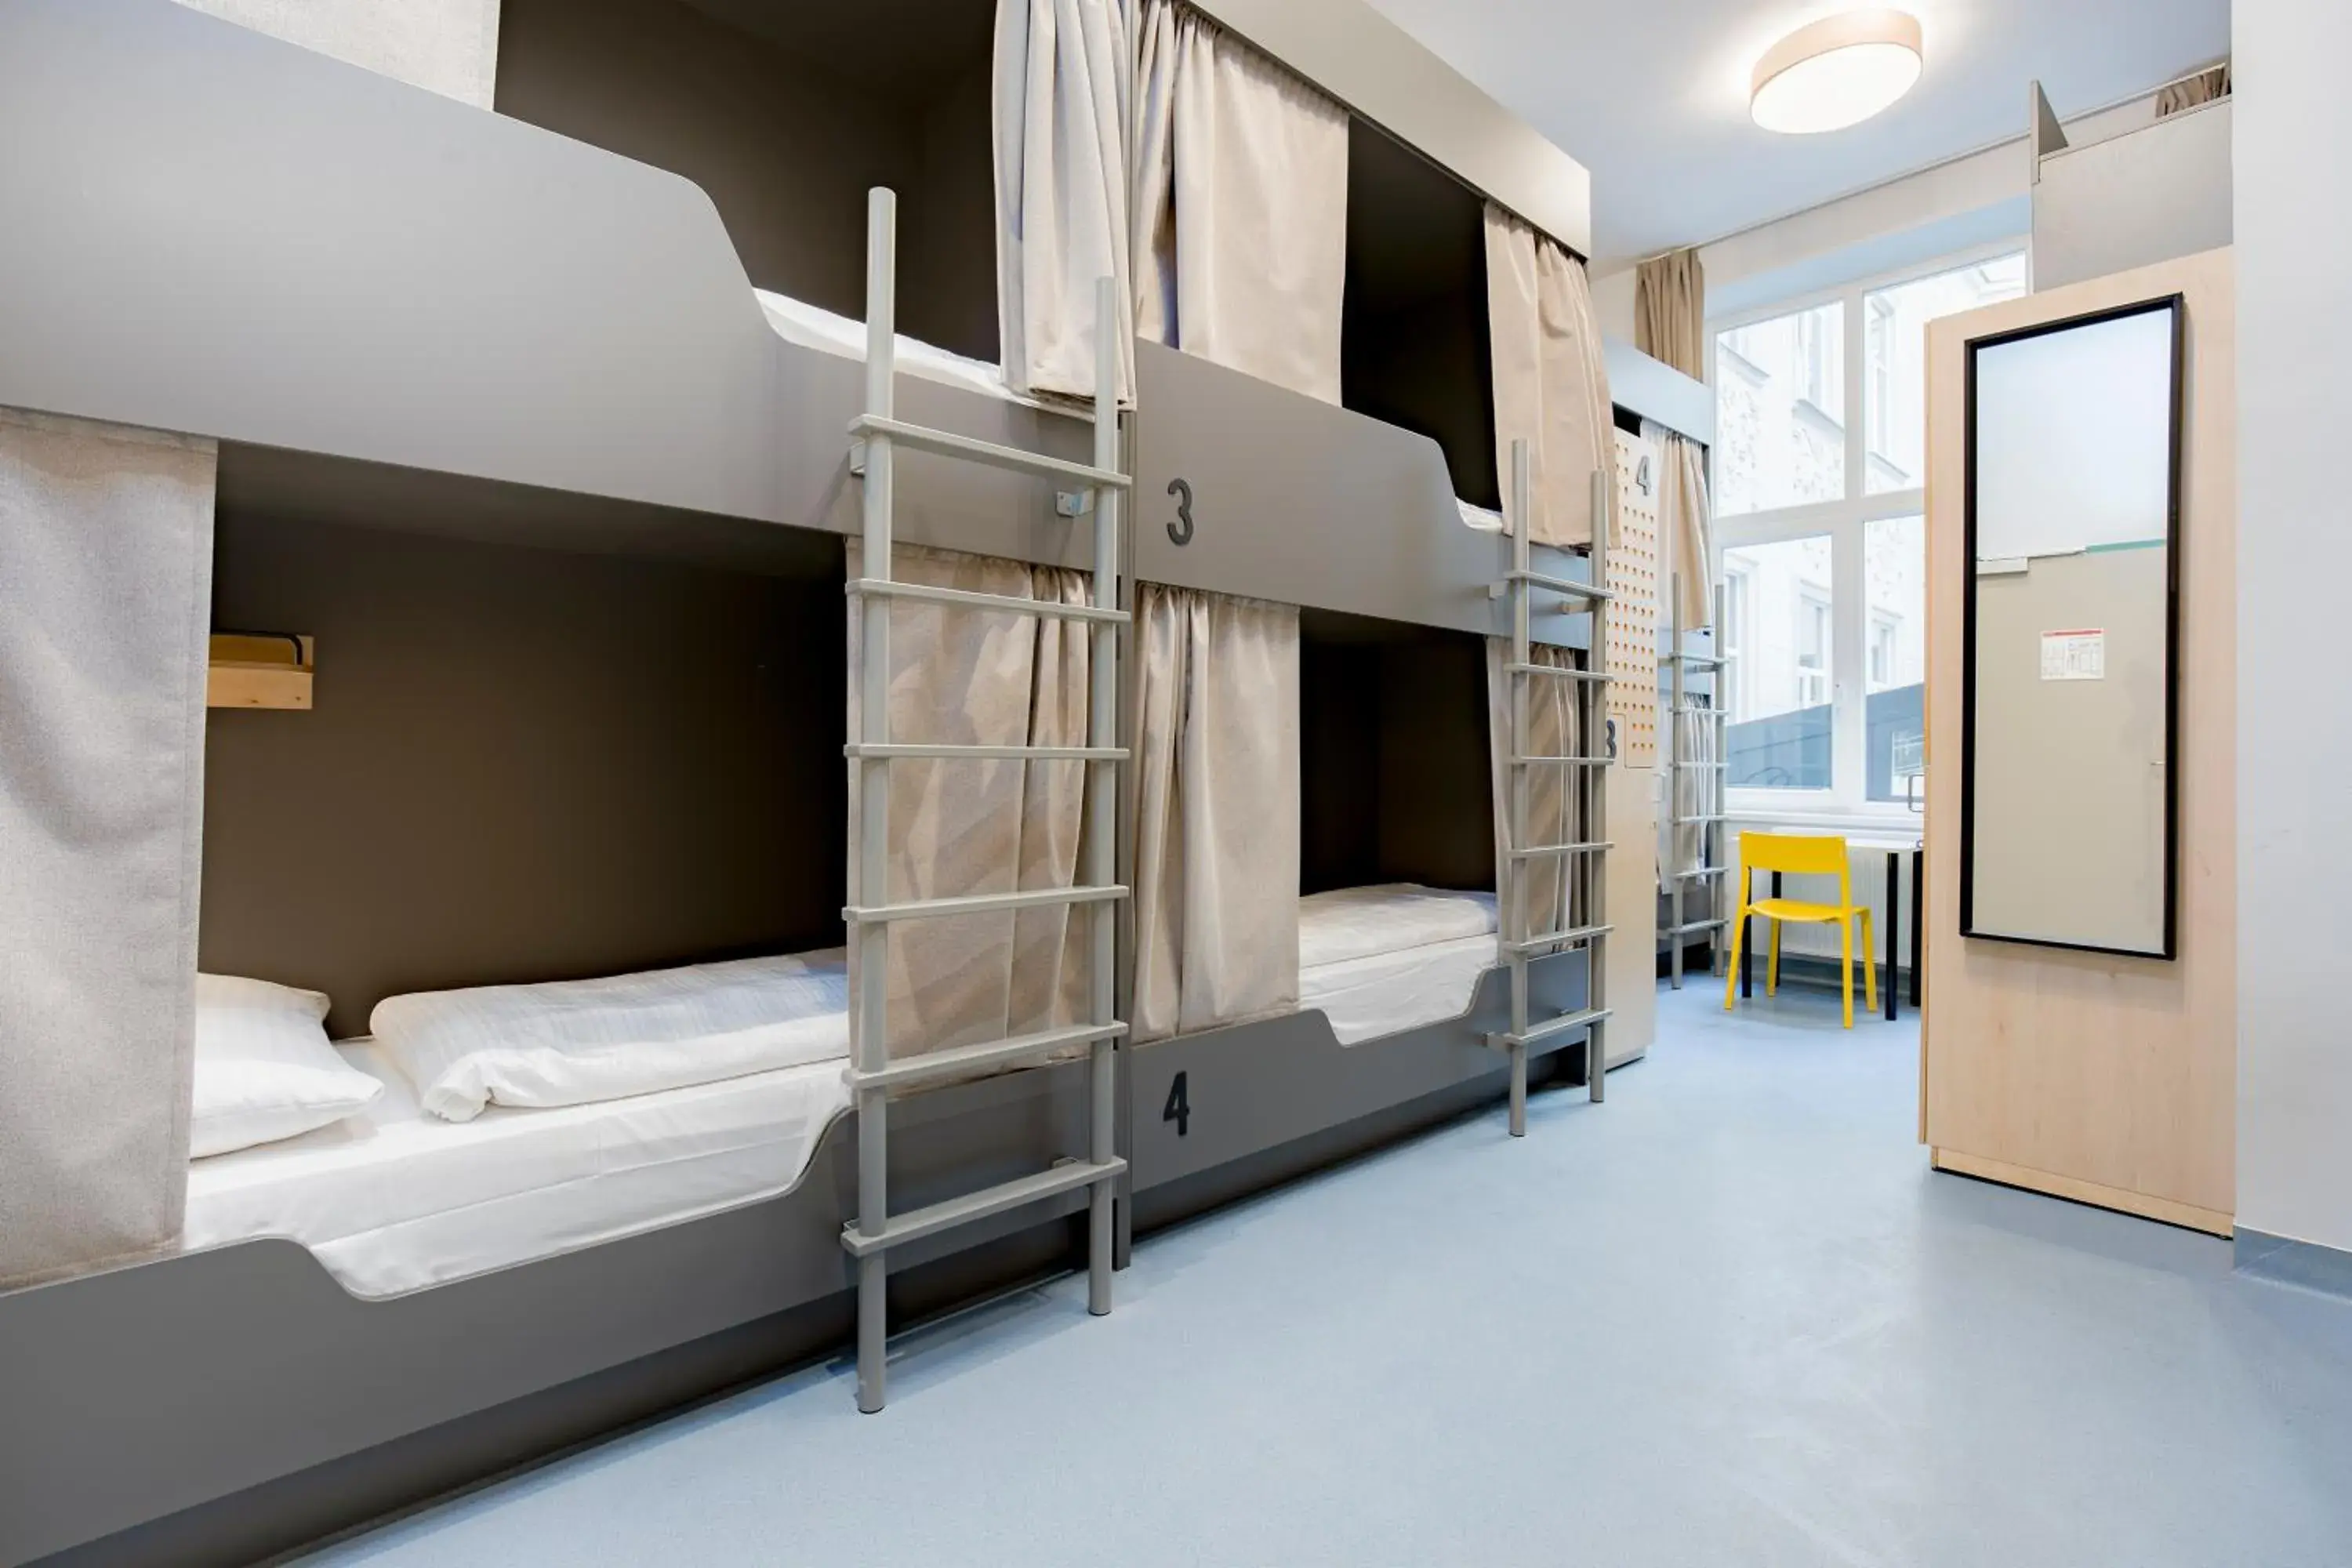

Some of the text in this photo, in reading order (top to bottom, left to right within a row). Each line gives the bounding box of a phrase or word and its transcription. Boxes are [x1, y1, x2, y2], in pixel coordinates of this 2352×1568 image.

[1636, 455, 1651, 496] 4
[1167, 477, 1193, 546] 3
[1163, 1071, 1189, 1136] 4
